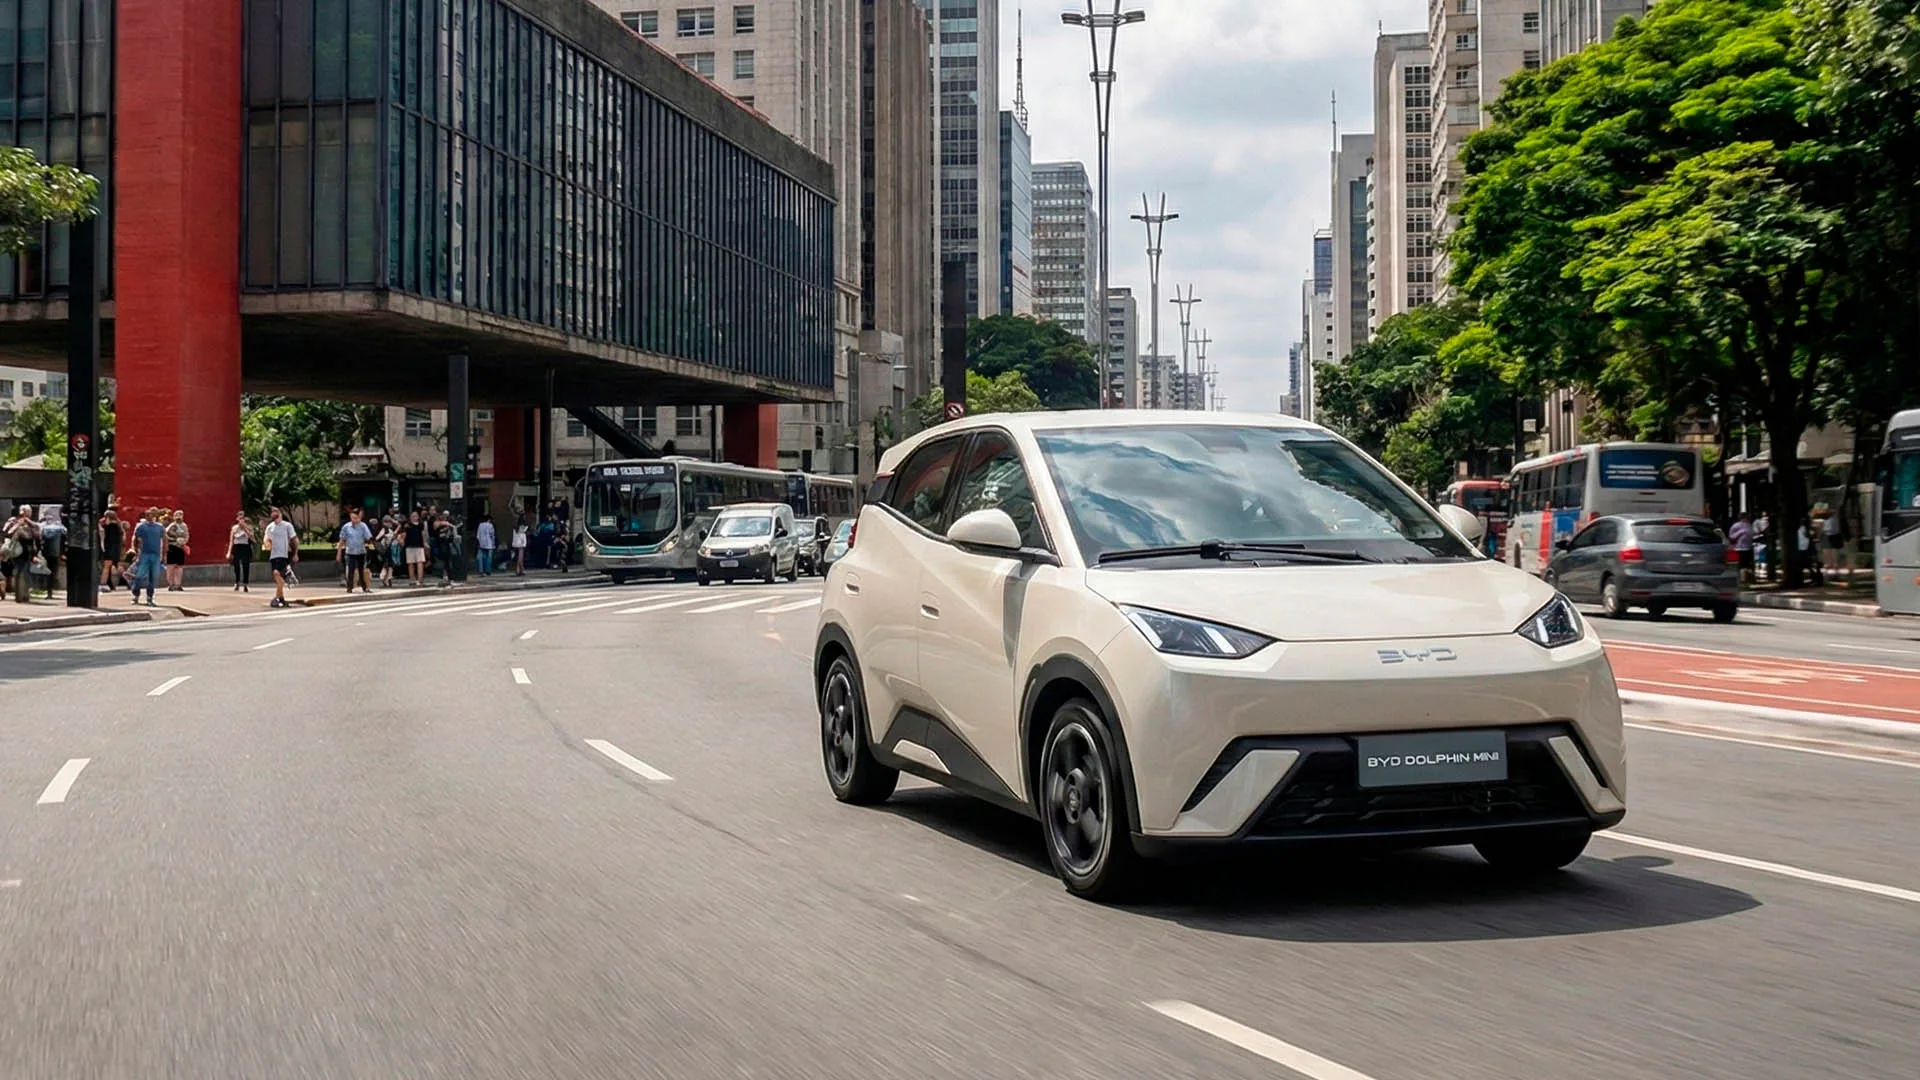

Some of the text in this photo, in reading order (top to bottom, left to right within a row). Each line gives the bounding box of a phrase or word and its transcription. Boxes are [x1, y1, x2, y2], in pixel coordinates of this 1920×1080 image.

[1377, 647, 1457, 664] BYD
[1367, 752, 1499, 768] BYD DOLPHIN MINI
